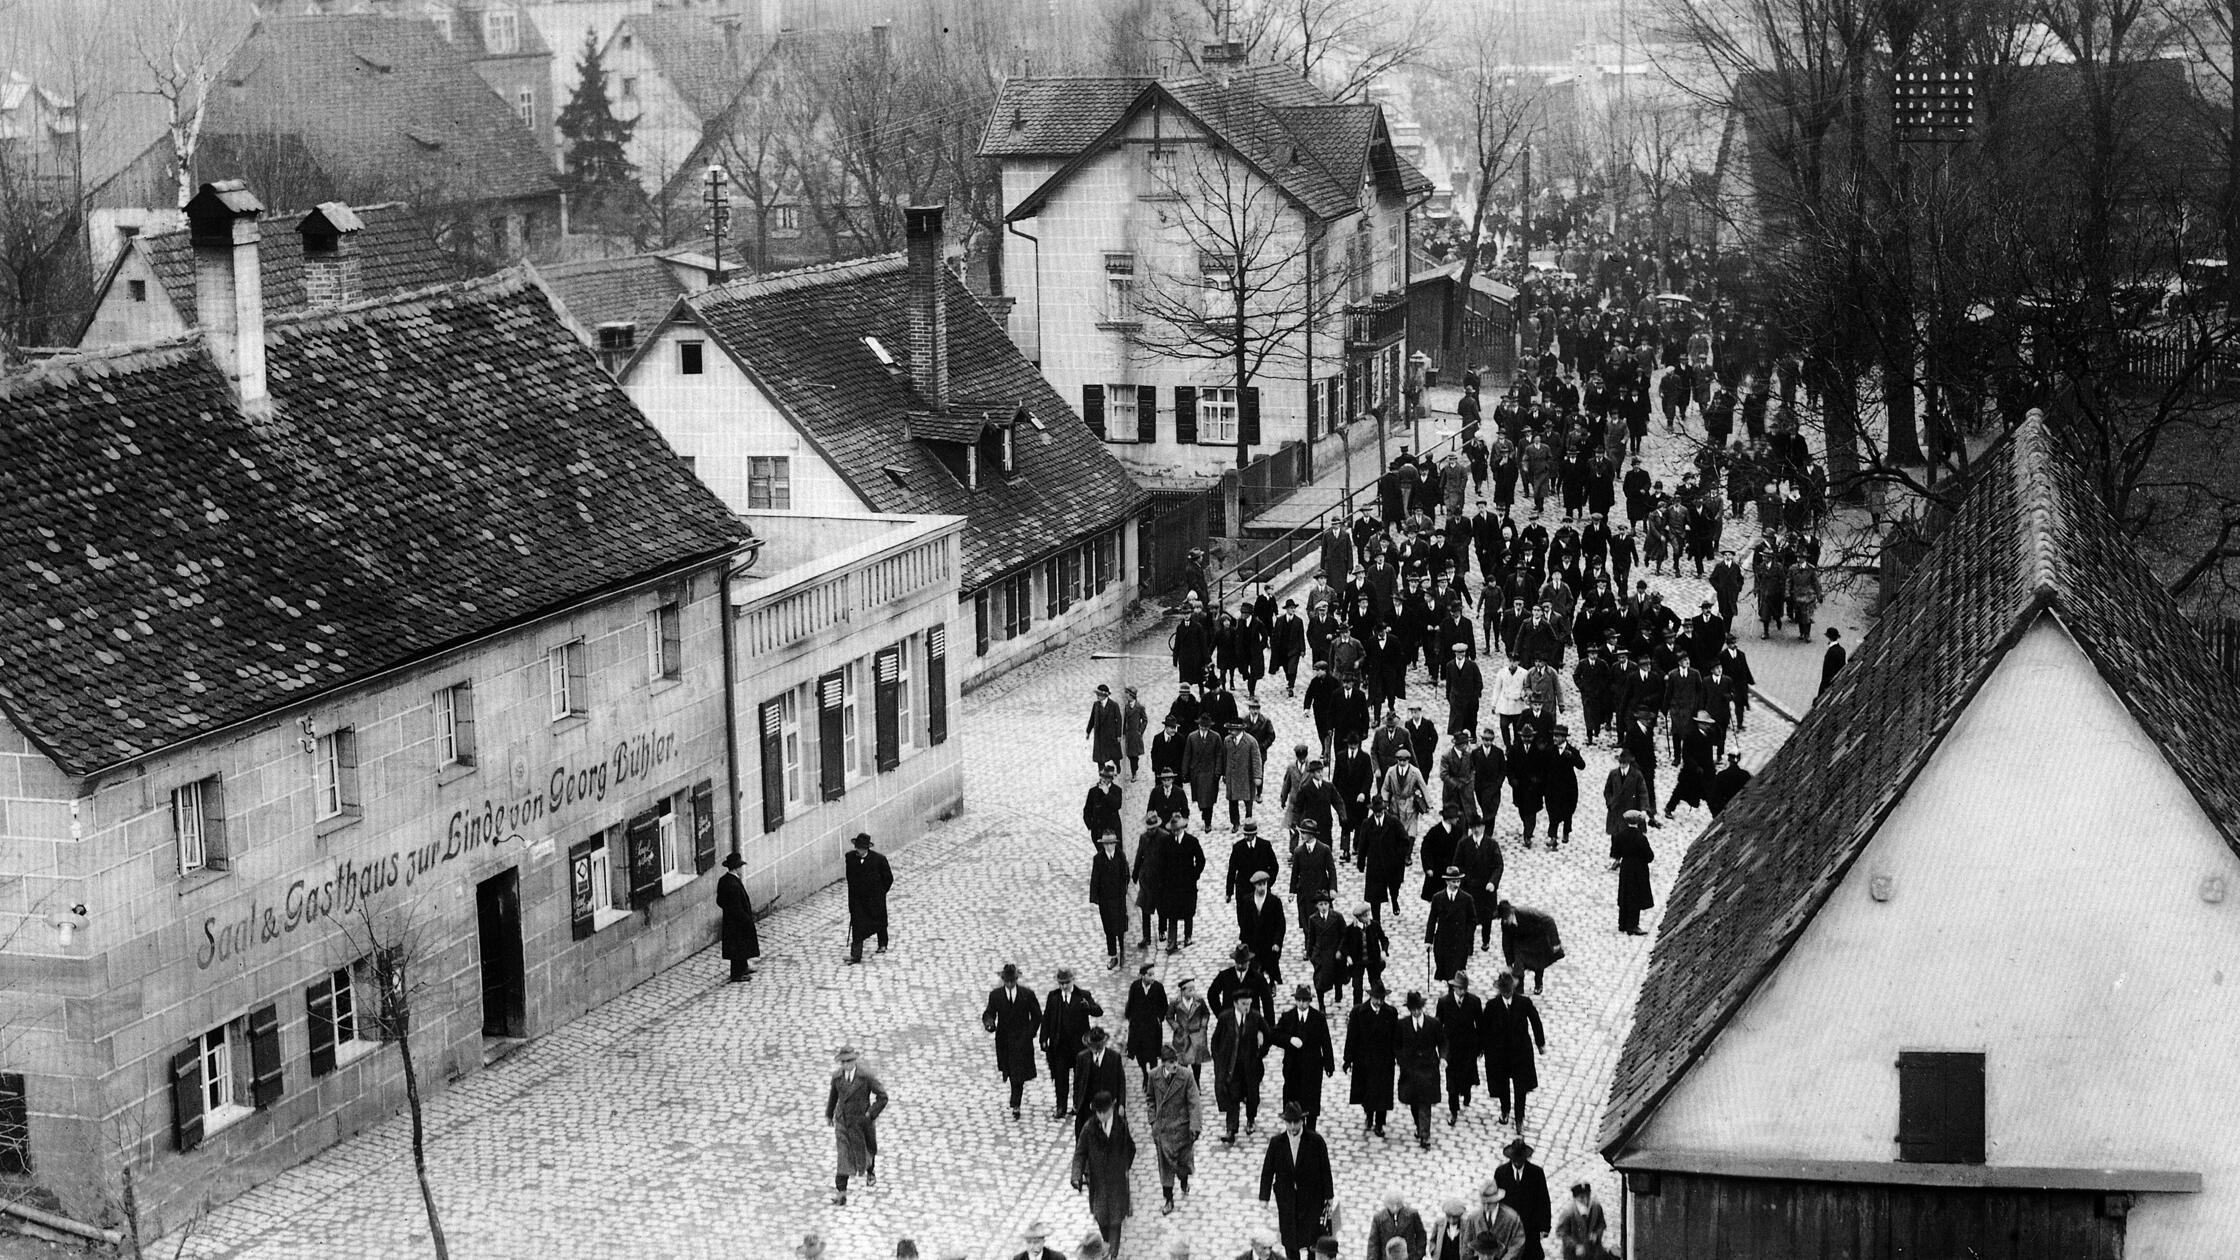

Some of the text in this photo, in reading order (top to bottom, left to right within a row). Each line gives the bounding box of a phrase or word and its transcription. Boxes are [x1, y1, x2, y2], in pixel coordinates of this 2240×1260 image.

[197, 728, 679, 970] Saal & Gasthaus zur Linde von Georg Bühler.
